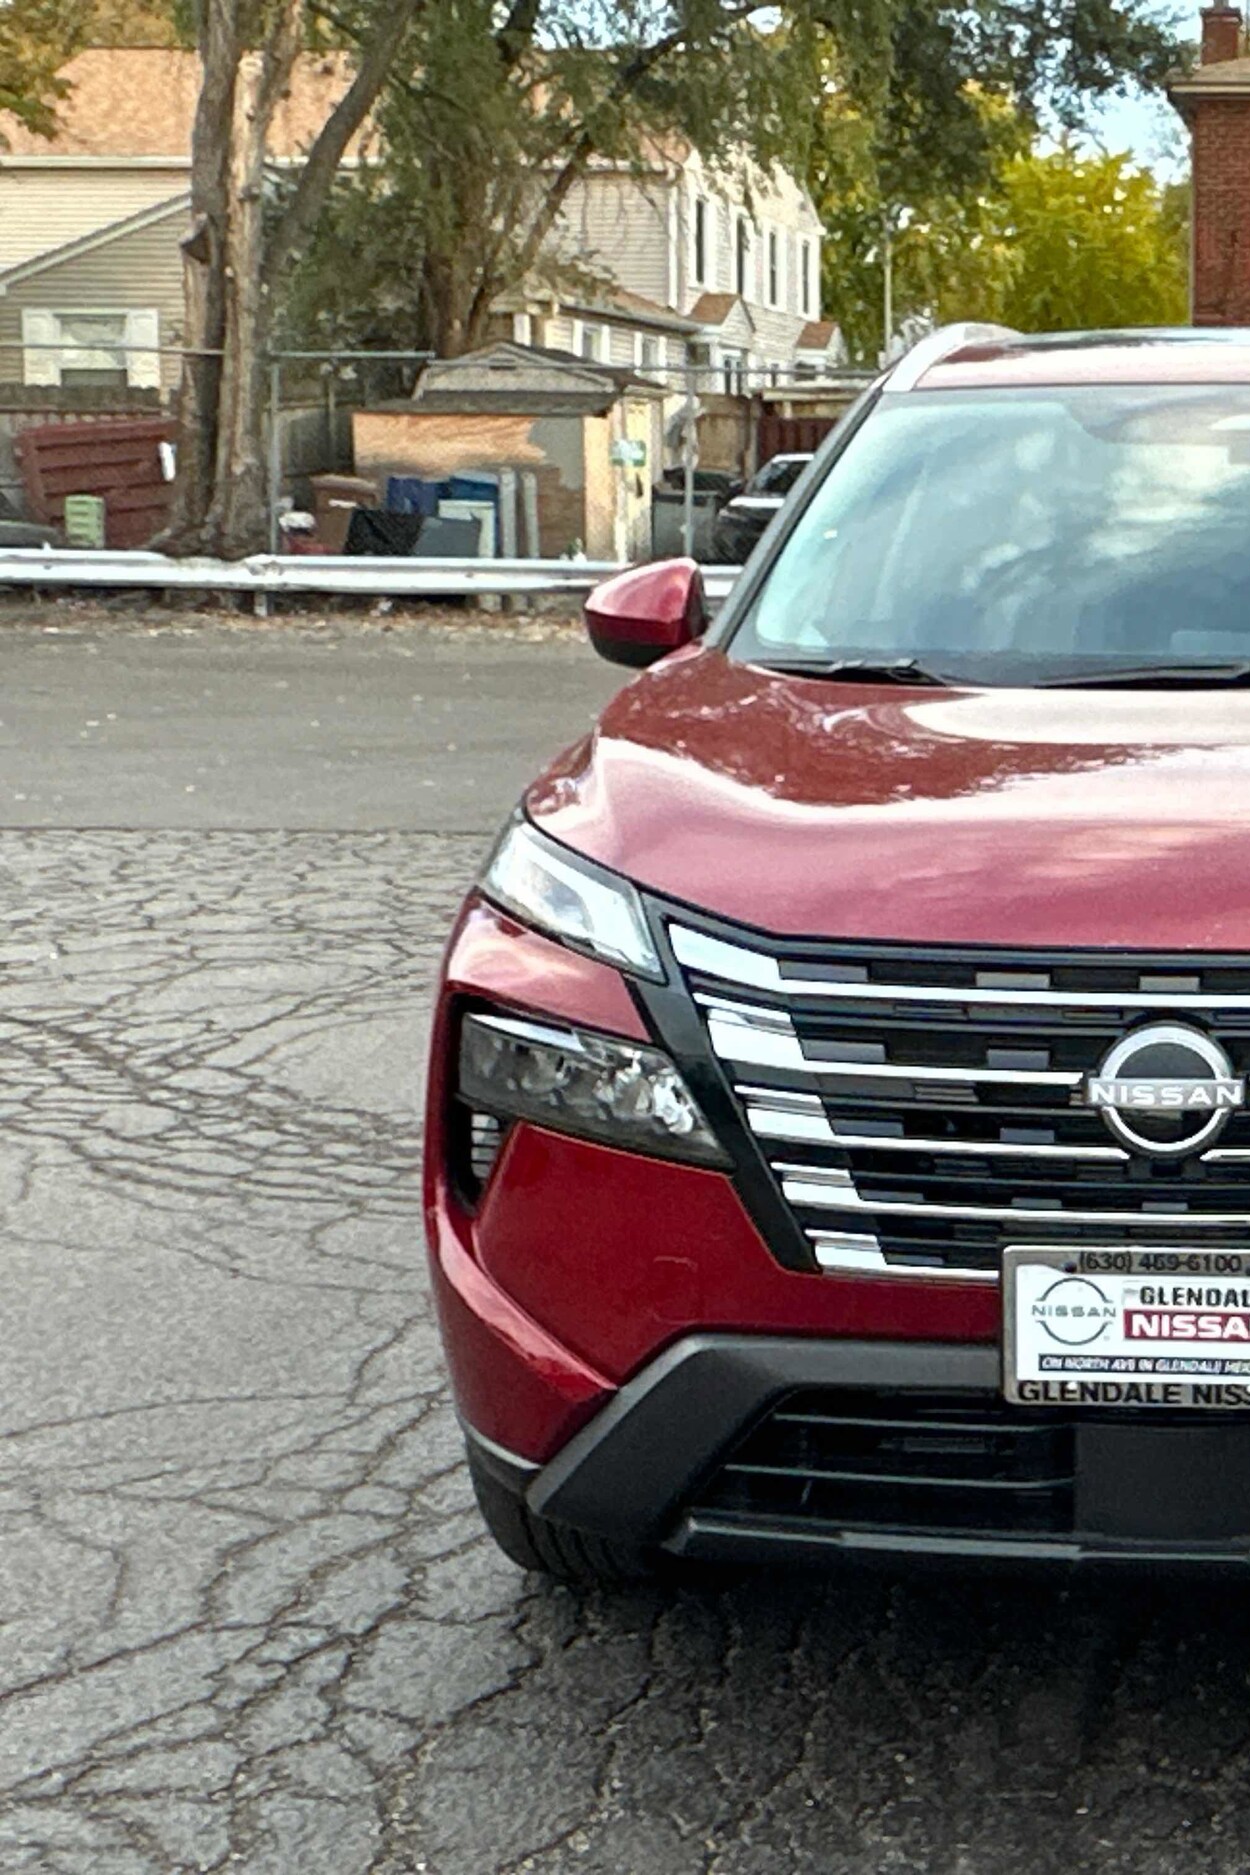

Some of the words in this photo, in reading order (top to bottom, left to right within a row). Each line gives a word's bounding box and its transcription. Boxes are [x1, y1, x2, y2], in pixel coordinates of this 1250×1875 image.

[1091, 1083, 1243, 1105] NISSAN
[1079, 1251, 1132, 1273] (630)
[1139, 1253, 1242, 1273] 469-6100
[1031, 1304, 1117, 1319] NISSAN
[1017, 1381, 1181, 1404] GLENDALE
